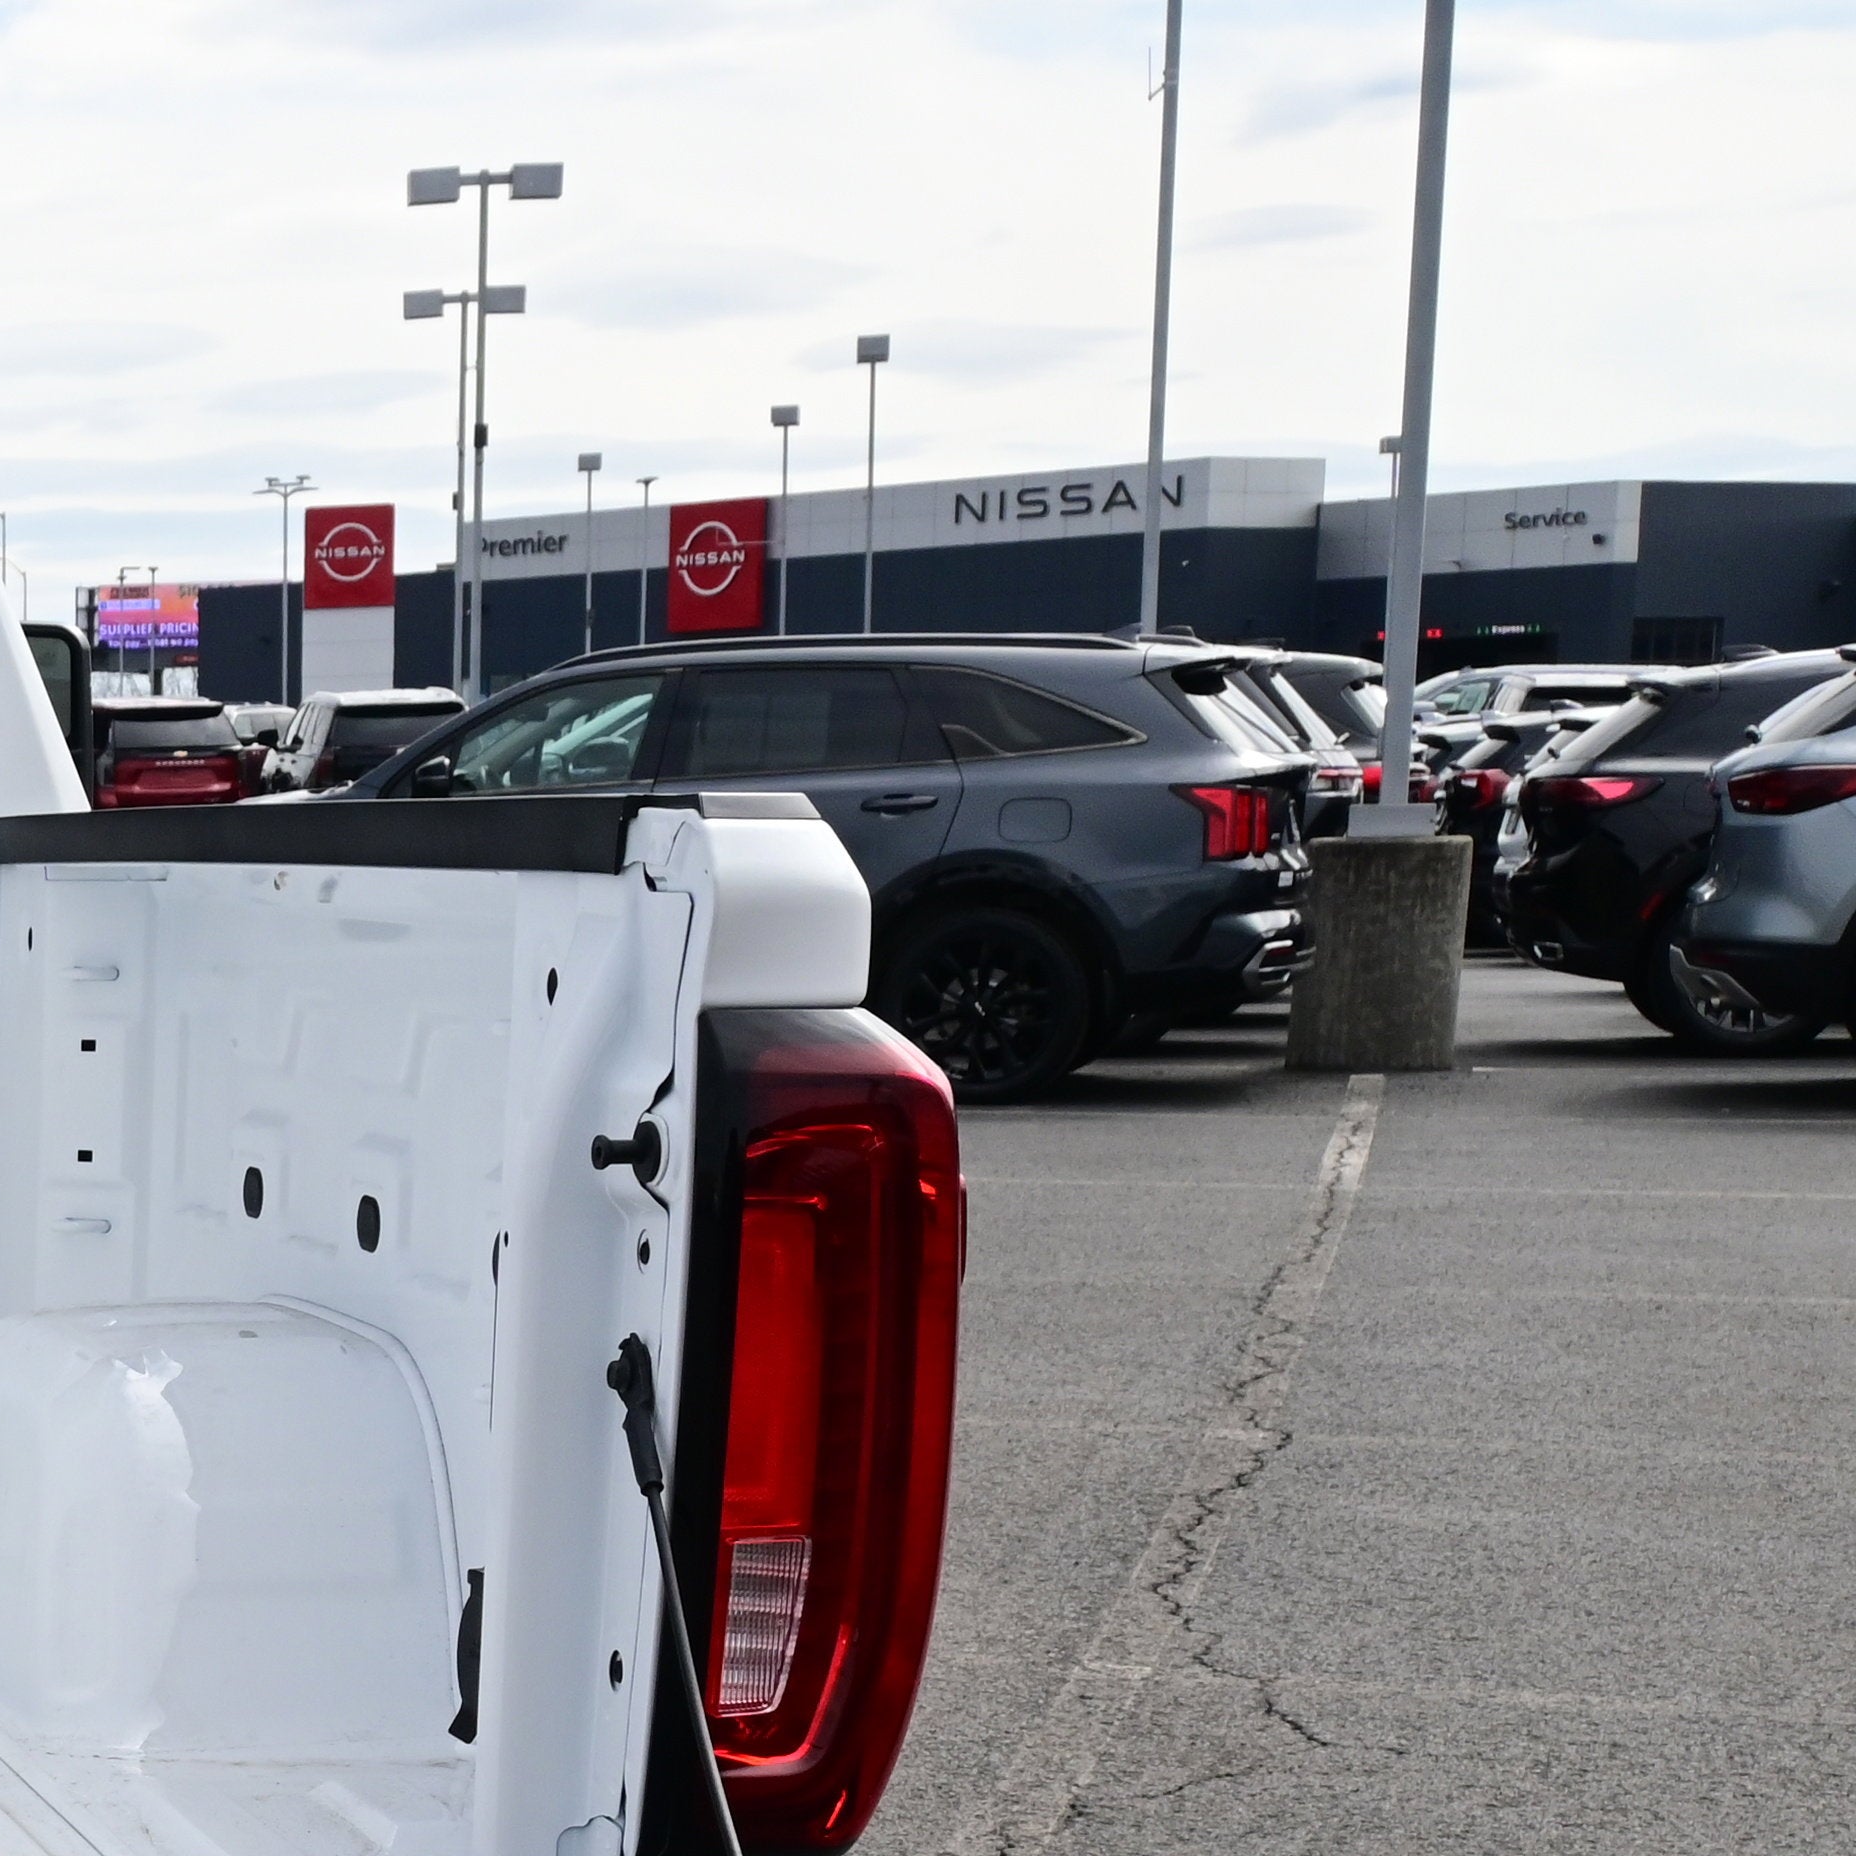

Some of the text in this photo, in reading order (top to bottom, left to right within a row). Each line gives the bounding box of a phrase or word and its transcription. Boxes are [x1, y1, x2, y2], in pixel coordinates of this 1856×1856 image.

[954, 474, 1185, 525] NISSAN
[1504, 507, 1588, 531] Service
[315, 545, 386, 561] NISSAN
[676, 549, 745, 567] NISSAN
